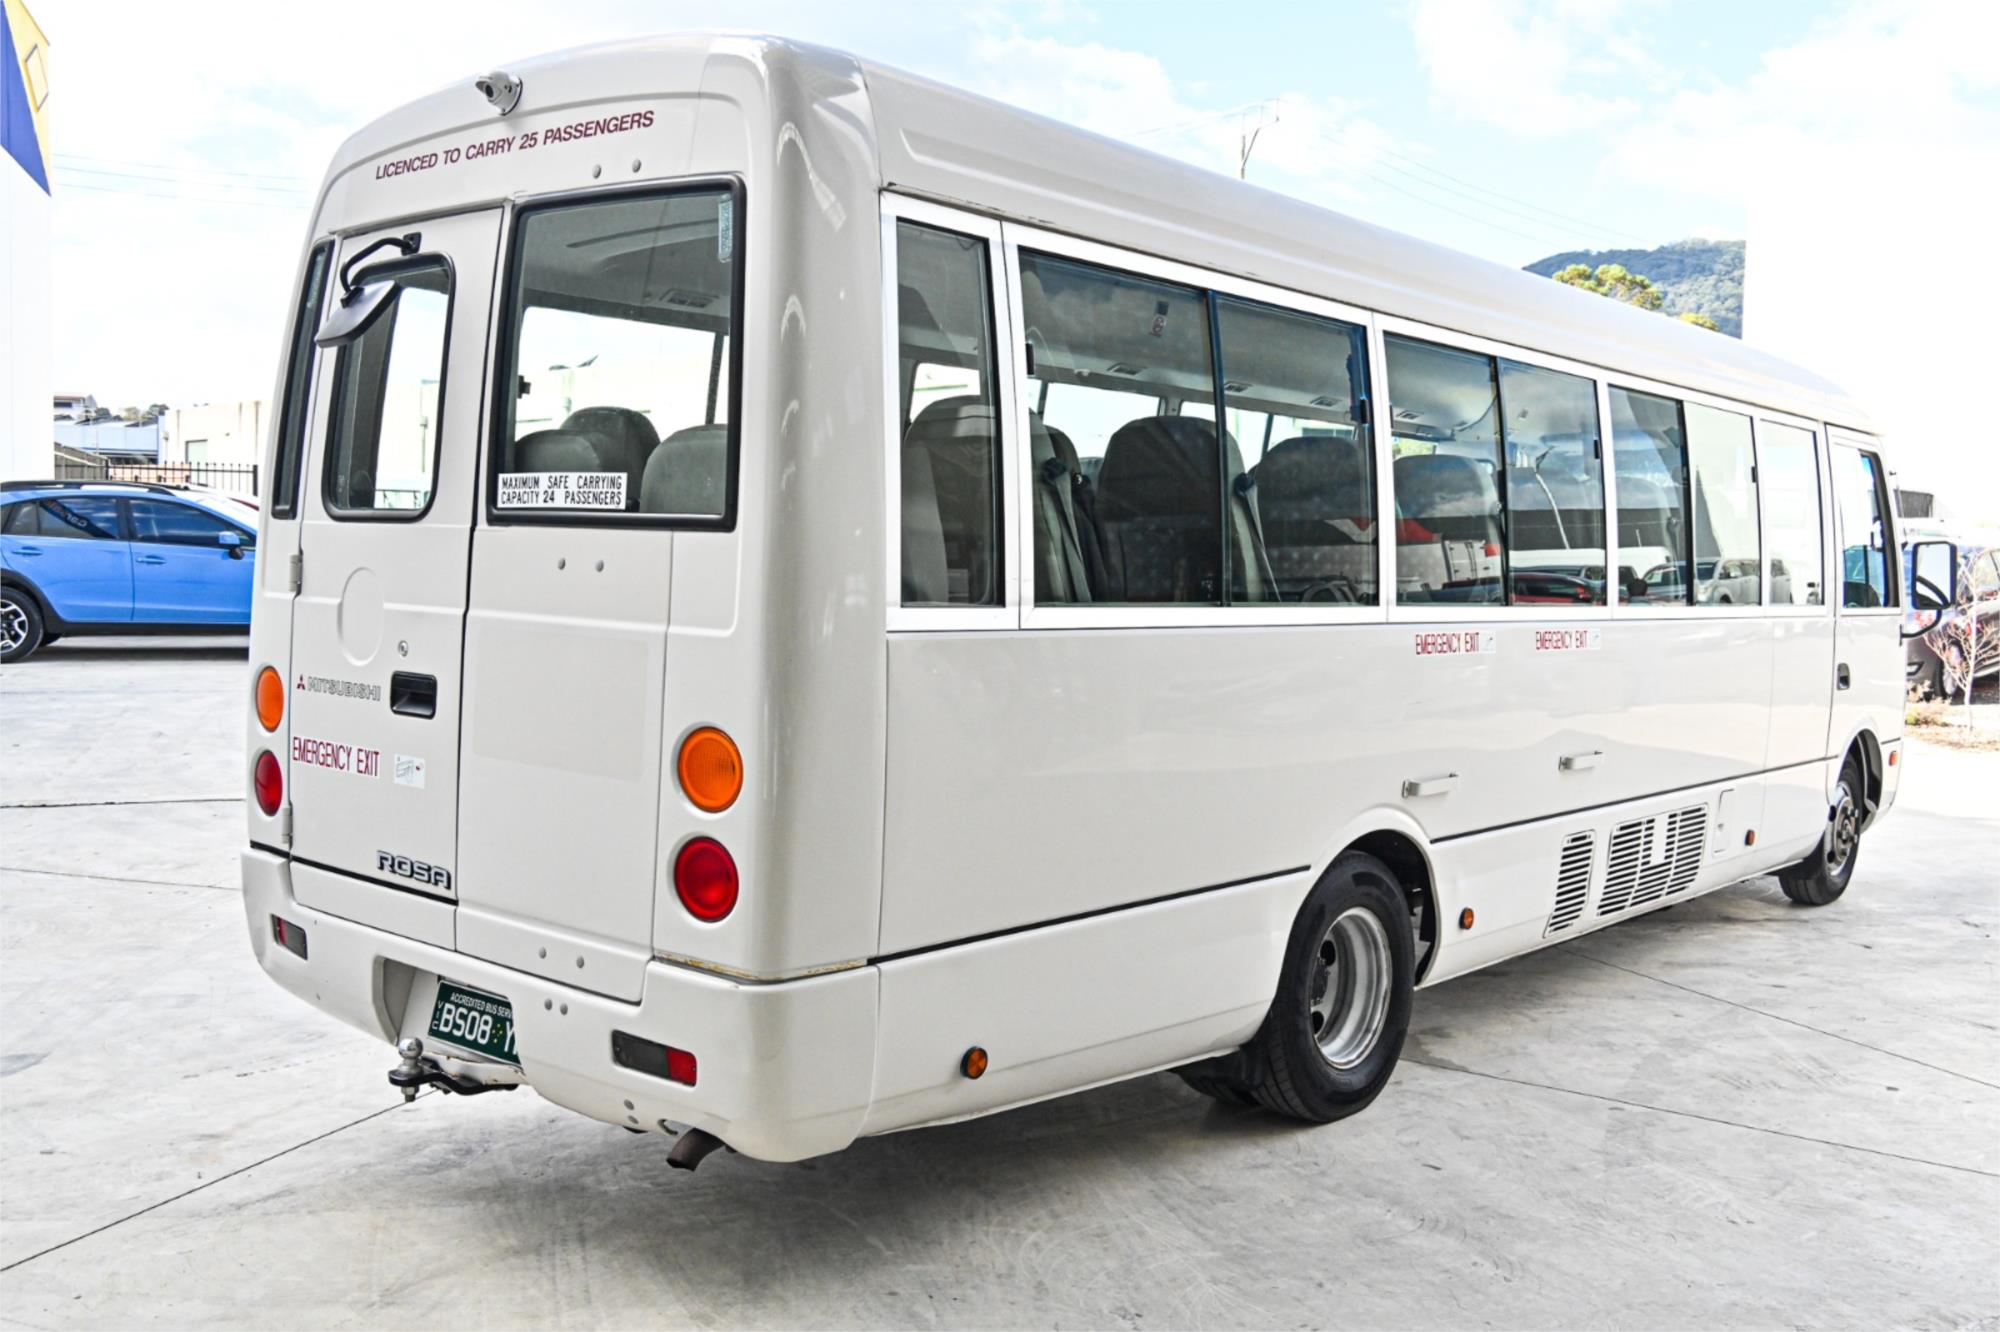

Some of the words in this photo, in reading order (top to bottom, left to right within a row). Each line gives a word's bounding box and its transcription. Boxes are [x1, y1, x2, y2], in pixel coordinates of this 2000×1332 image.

[375, 152, 439, 180] LICENCED
[443, 147, 461, 166] TO
[465, 136, 516, 161] CARRY
[519, 131, 538, 151] 25
[542, 110, 655, 146] PASSENGERS
[502, 476, 540, 490] MAXIMUM
[547, 475, 569, 490] SAFE
[577, 475, 622, 490] CARRYING
[501, 490, 539, 505] CAPACITY
[543, 491, 555, 504] 24
[564, 490, 622, 506] PASSENGERS
[1415, 632, 1461, 655] EMERGENCY
[1464, 631, 1480, 653] EXIT
[1536, 630, 1573, 650] EMERGENCY
[1575, 630, 1588, 648] EXIT
[307, 676, 382, 702] MITSUBISHI
[292, 736, 353, 771] EMERGENCY
[356, 748, 380, 777] EXIT
[376, 850, 451, 890] ROSA
[450, 992, 485, 1010] ACCREDITED
[484, 1002, 498, 1015] BUS
